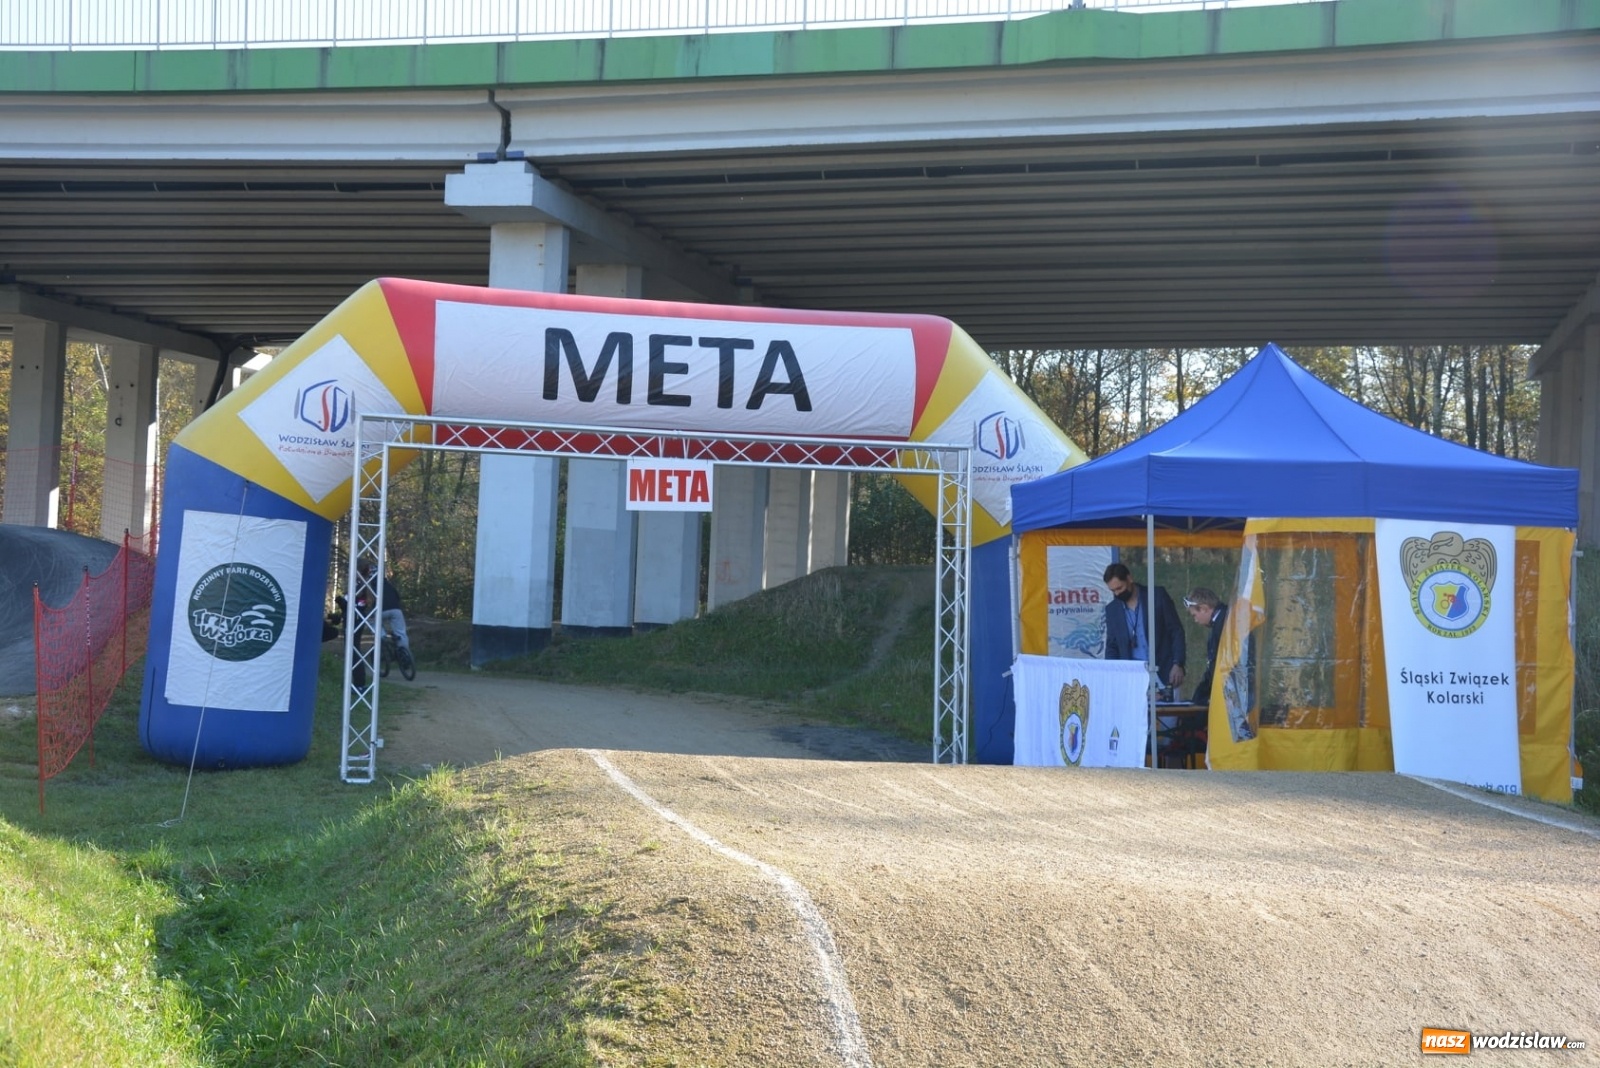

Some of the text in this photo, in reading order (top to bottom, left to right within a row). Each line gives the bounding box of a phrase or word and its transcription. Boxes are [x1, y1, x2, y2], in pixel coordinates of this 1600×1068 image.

[542, 327, 812, 412] META
[278, 434, 339, 447] WODZISŁAW
[972, 465, 1014, 474] ODZISŁAW
[629, 468, 710, 503] META
[193, 566, 282, 602] RODZINNY PARK ROZRYWKI
[193, 608, 241, 634] Trzy
[1056, 606, 1094, 616] pływalnia
[1400, 667, 1510, 688] Śląski Związek
[1426, 691, 1484, 704] Kolarski
